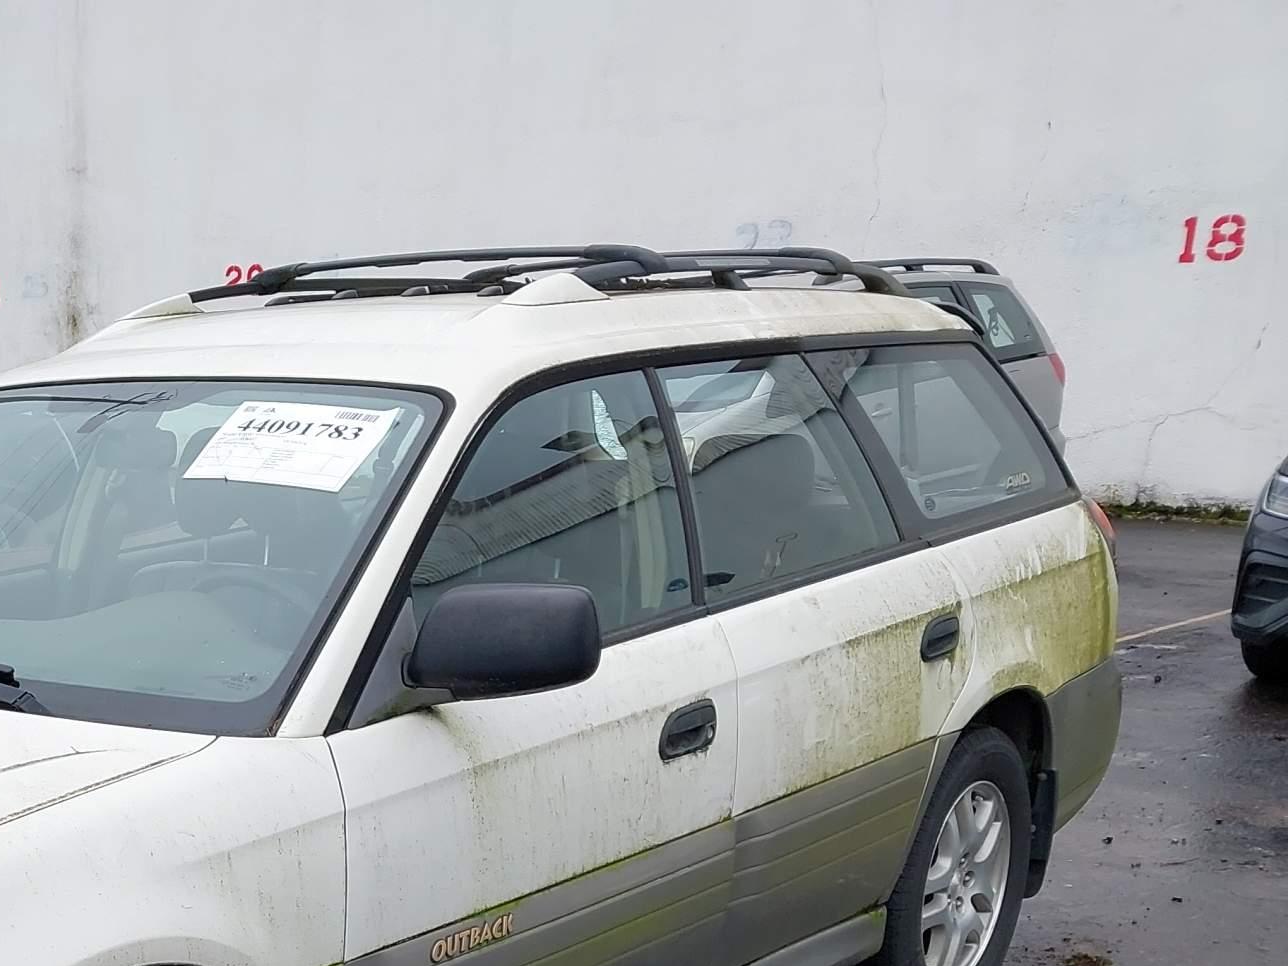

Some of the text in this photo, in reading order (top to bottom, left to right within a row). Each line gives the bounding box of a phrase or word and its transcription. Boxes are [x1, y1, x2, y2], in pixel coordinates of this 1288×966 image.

[1178, 214, 1246, 264] 18
[237, 417, 365, 441] 44091783
[1006, 472, 1031, 488] AWD
[430, 912, 514, 963] OUTBACK
